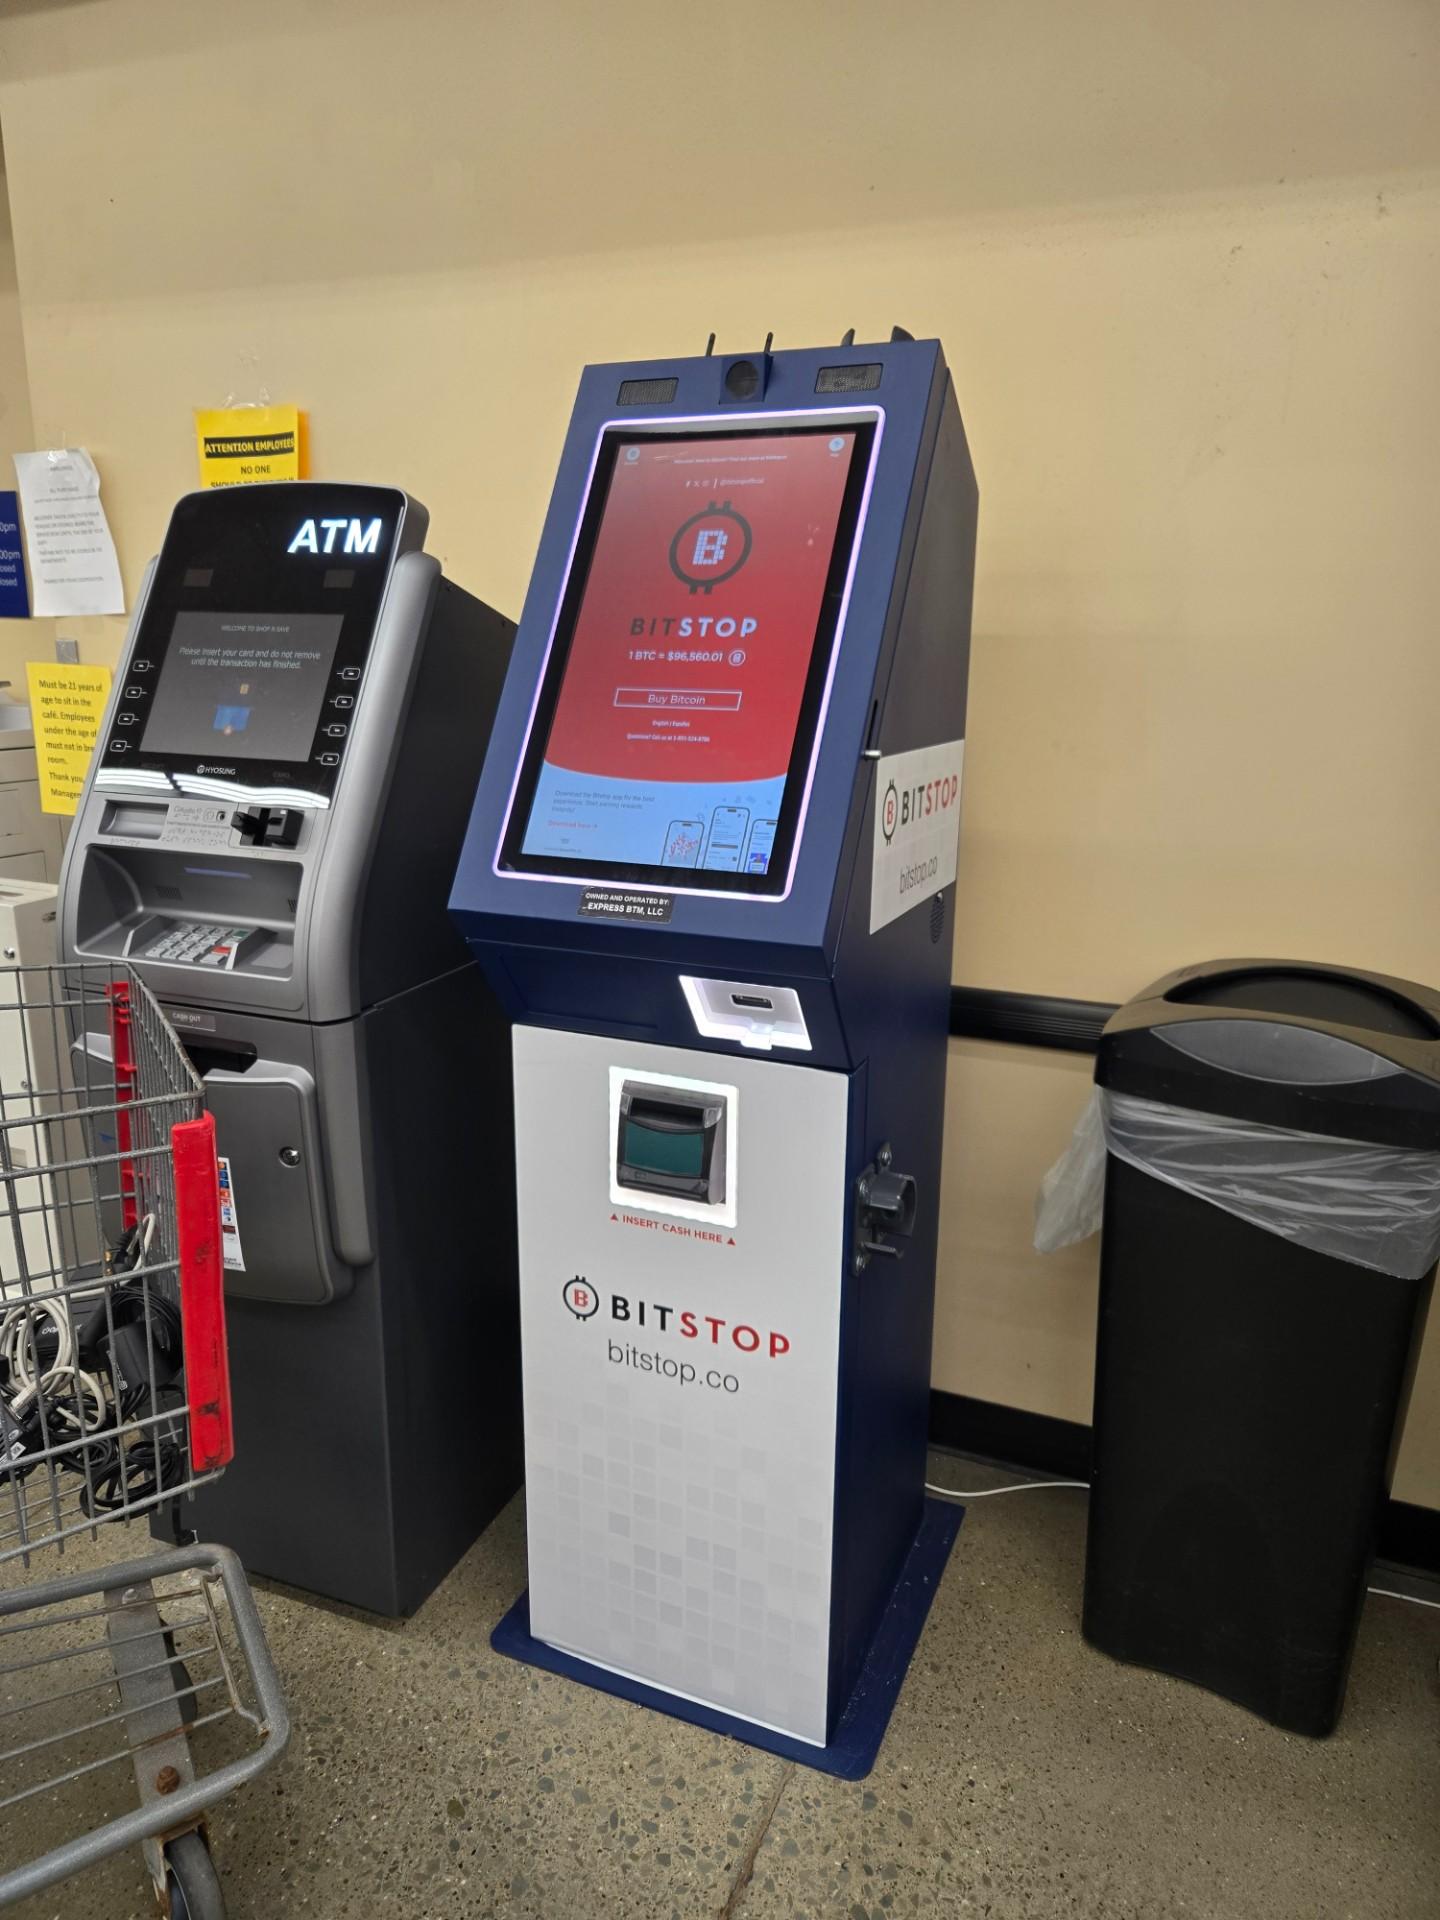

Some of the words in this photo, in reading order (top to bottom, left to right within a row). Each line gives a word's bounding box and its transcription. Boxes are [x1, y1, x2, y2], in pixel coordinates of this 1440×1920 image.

[205, 441, 254, 454] ATTENTION
[255, 438, 294, 452] EMPLOYEES
[240, 466, 253, 475] NO
[254, 464, 271, 474] ONE
[286, 518, 382, 554] ATM
[220, 624, 247, 633] WELCOME
[629, 616, 758, 638] BITSTOP
[179, 647, 200, 656] Please
[201, 647, 221, 657] insert
[222, 649, 238, 658] your
[238, 649, 254, 658] card
[254, 649, 270, 658] and
[270, 650, 280, 658] do
[280, 651, 293, 659] not
[293, 652, 321, 661] remove
[634, 651, 657, 661] BTC
[667, 650, 723, 663] $96,560.01
[191, 657, 206, 666] until
[207, 657, 219, 666] the
[219, 658, 258, 668] transaction
[258, 660, 272, 669] has
[39, 679, 58, 689] Must
[57, 680, 67, 690] be
[68, 681, 77, 691] 21
[78, 683, 95, 692] years
[95, 682, 103, 692] of
[41, 696, 53, 706] age
[54, 696, 63, 704] to
[63, 697, 71, 705] sit
[72, 697, 79, 705] in
[80, 698, 91, 706] the
[648, 694, 668, 705] Buy
[670, 694, 706, 705] Bitcoin
[60, 712, 96, 723] Employees
[44, 727, 64, 735] under
[65, 728, 77, 736] the
[78, 730, 89, 738] age
[46, 742, 63, 750] must
[47, 757, 68, 765] room.
[49, 771, 70, 781] Thank
[204, 766, 236, 776] HYOSUNG
[901, 775, 959, 826] BITSTOP
[899, 855, 938, 894] bitstop.co
[585, 892, 609, 901] OWNED
[609, 894, 623, 902] AND
[624, 895, 659, 905] OPERATED
[587, 902, 625, 913] EXPRESS
[625, 906, 646, 916] BTM,
[647, 907, 664, 916] LLC
[622, 1213, 660, 1230] INSERT
[662, 1222, 691, 1238] CASH
[694, 1229, 723, 1244] HERE
[611, 1294, 790, 1359] BITSTOP
[608, 1338, 740, 1394] bitstop.co
